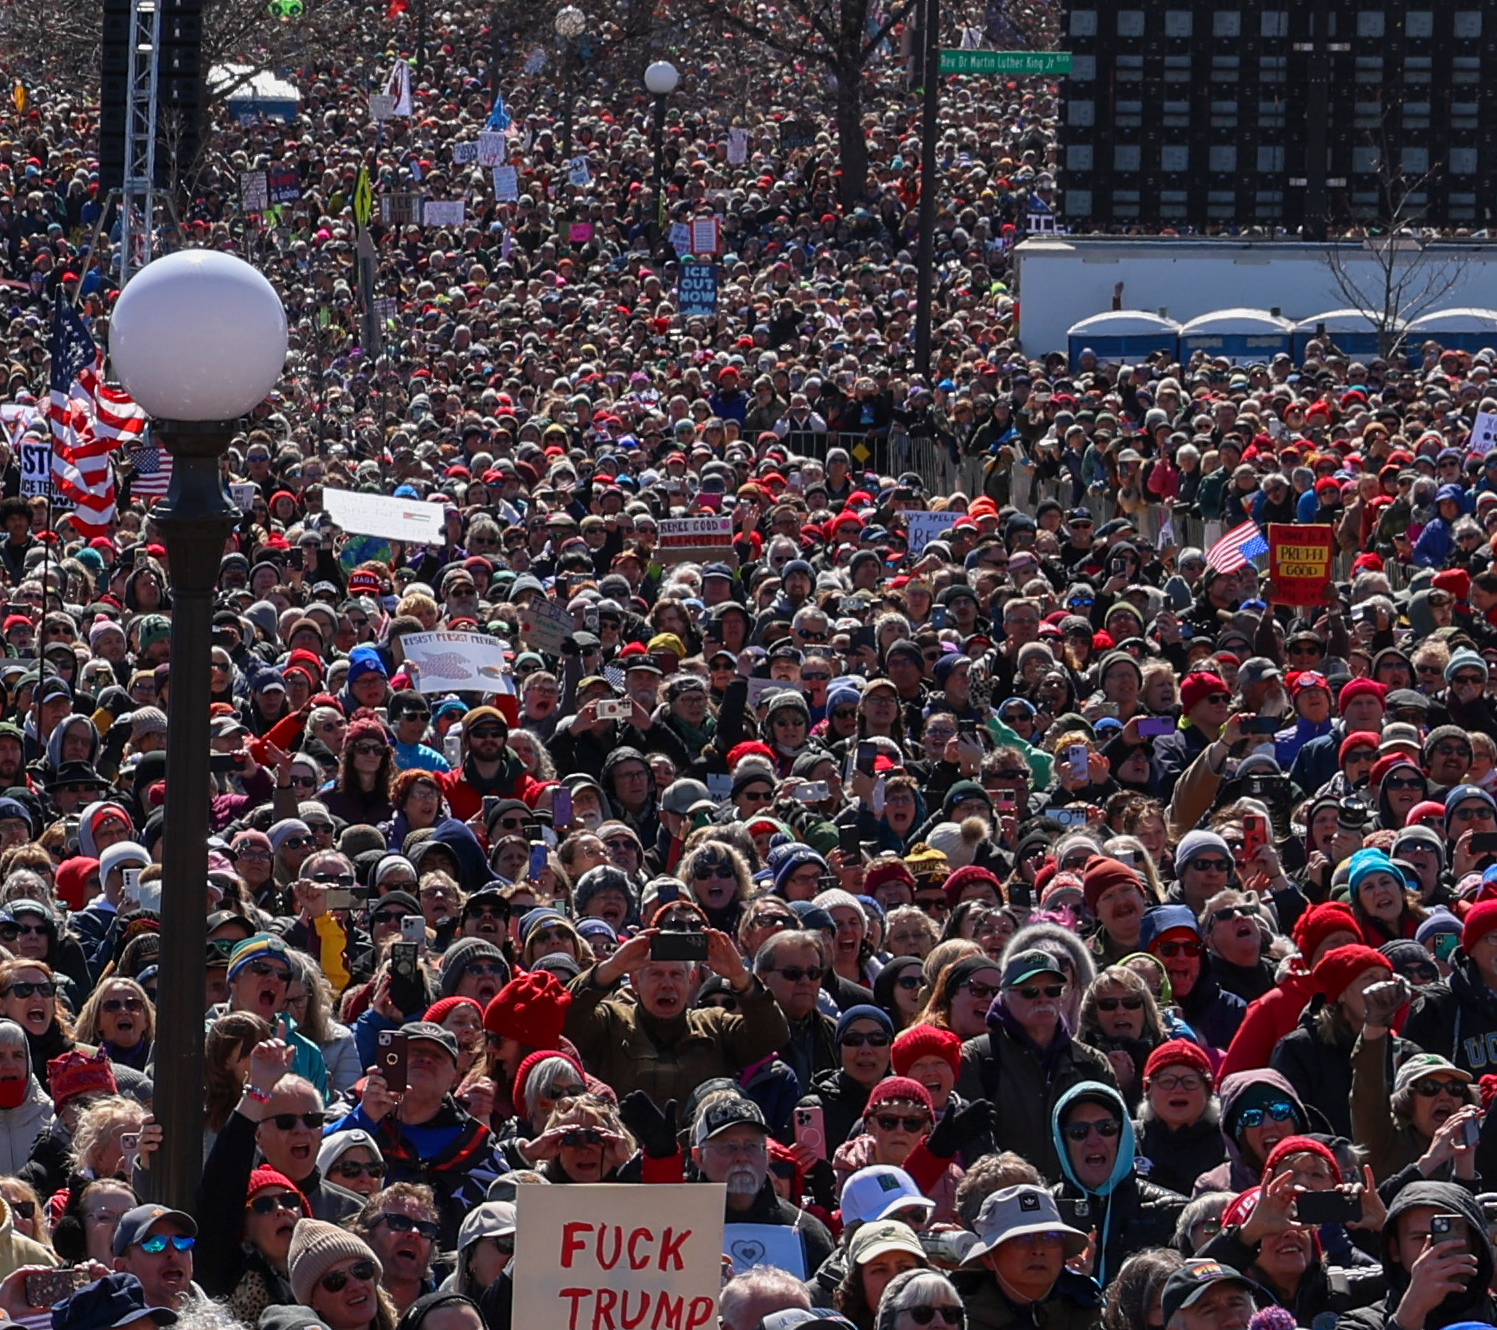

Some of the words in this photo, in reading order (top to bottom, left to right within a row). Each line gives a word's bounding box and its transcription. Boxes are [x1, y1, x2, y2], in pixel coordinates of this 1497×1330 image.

[940, 55, 957, 70] Rev
[959, 55, 968, 70] Dr
[970, 54, 995, 70] Martin
[997, 54, 1025, 71] Luther
[1027, 54, 1044, 73] King
[685, 267, 709, 277] ICE
[681, 279, 714, 289] OUT
[679, 291, 716, 302] NOW
[21, 480, 35, 495] ICE
[661, 522, 690, 533] RENEE
[694, 521, 718, 531] GOOD
[1280, 547, 1324, 561] PRETTI
[1285, 565, 1318, 576] GOOD
[353, 576, 376, 585] MAGA
[404, 634, 434, 647] RESIST
[436, 632, 468, 643] PERSIST
[560, 1222, 688, 1272] FUCK
